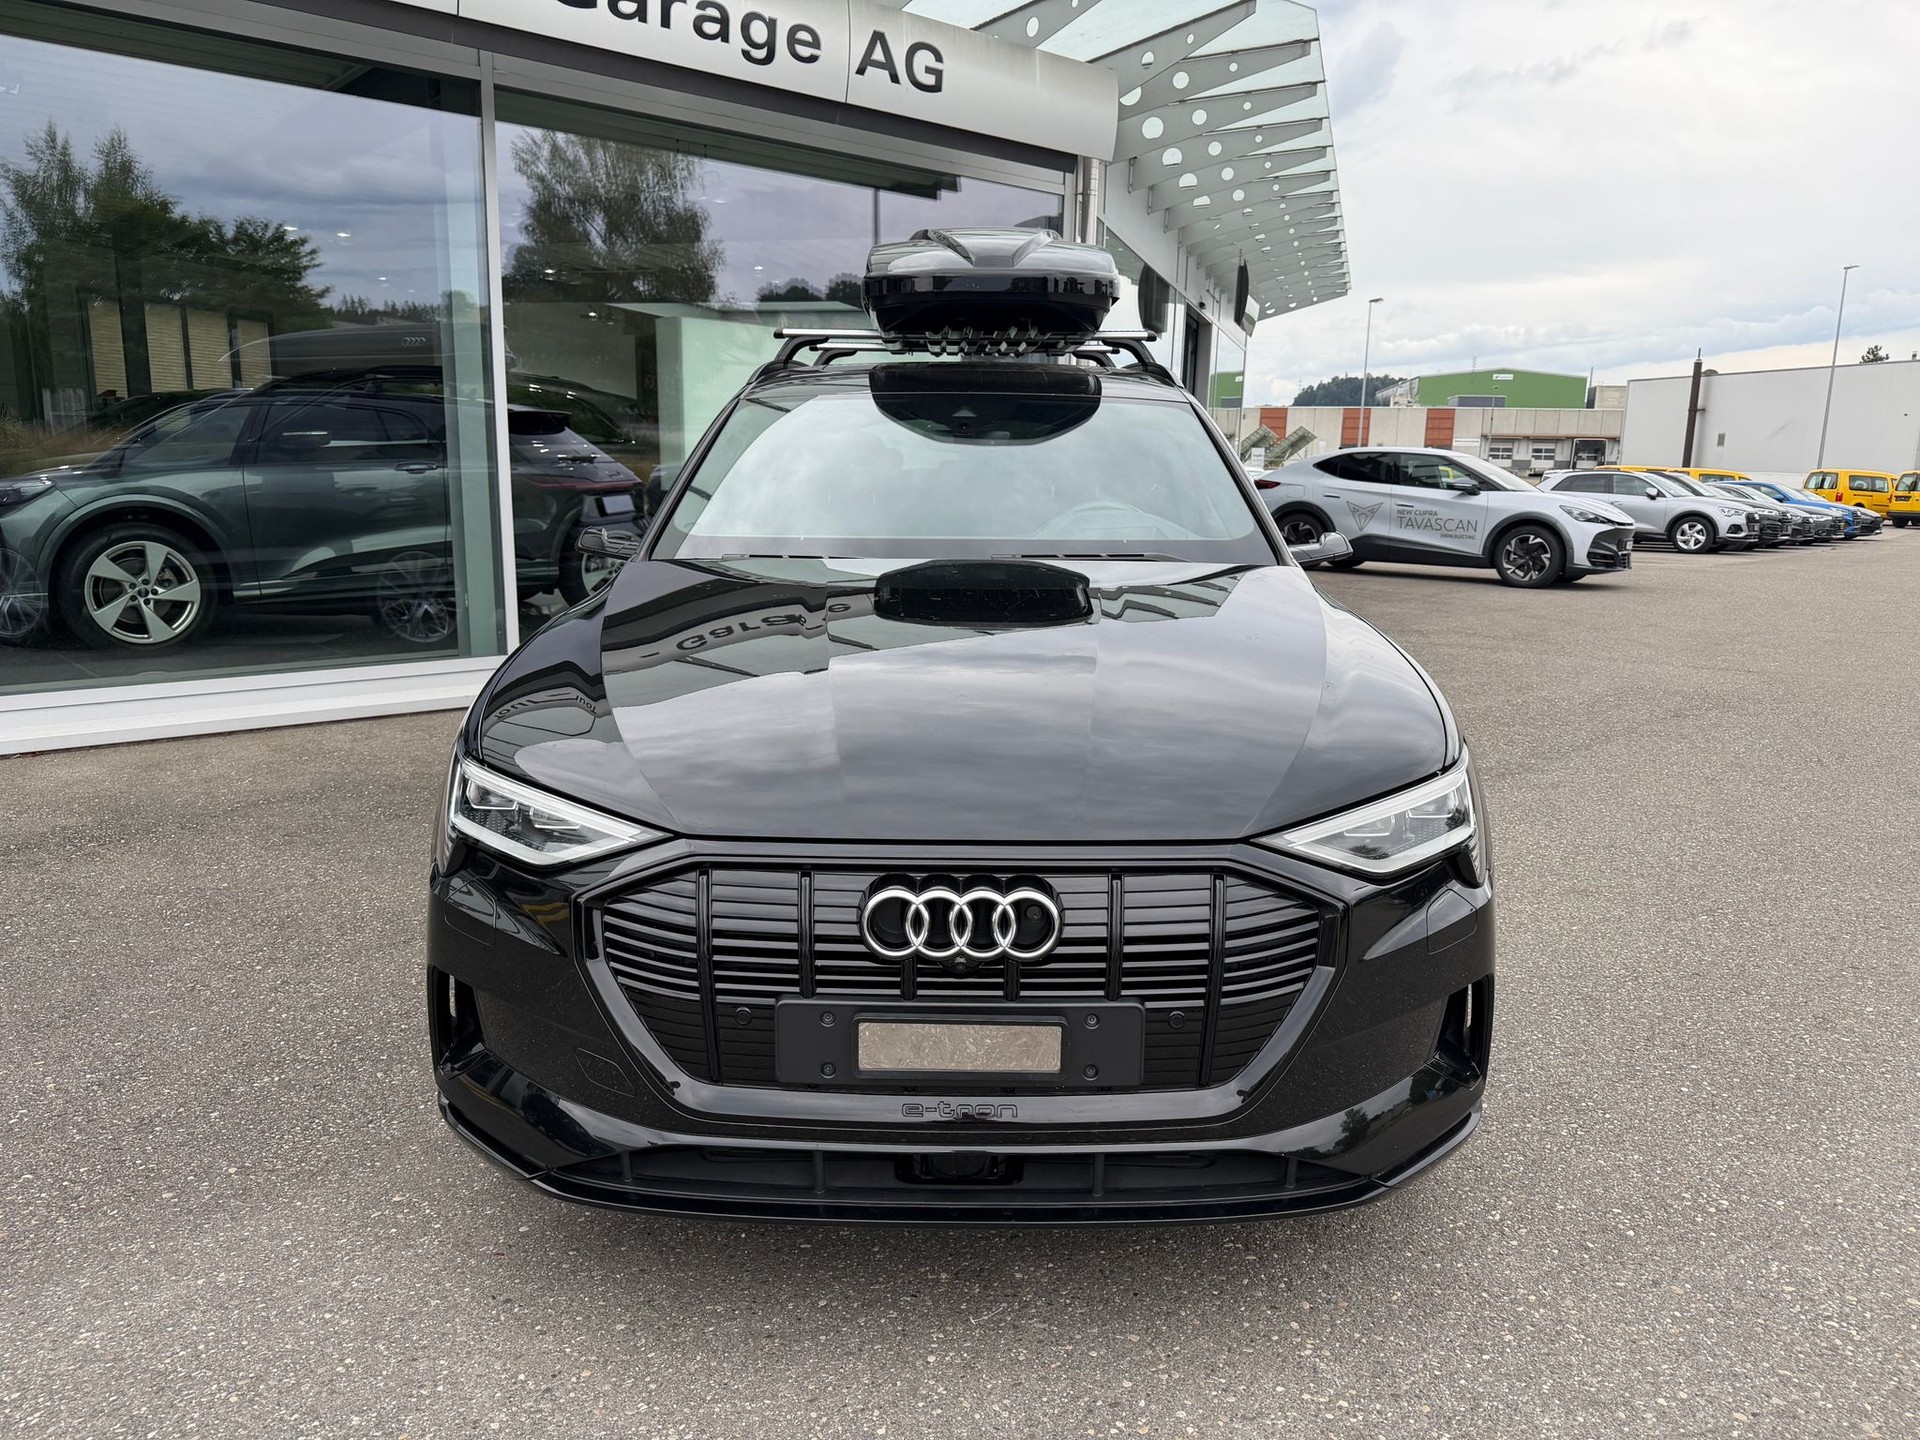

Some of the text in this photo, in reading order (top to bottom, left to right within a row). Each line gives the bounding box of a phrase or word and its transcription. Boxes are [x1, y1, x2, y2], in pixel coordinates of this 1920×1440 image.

[556, 0, 944, 93] arage AG
[1396, 516, 1478, 533] TAVASCAN
[902, 1101, 1019, 1119] e-tron
